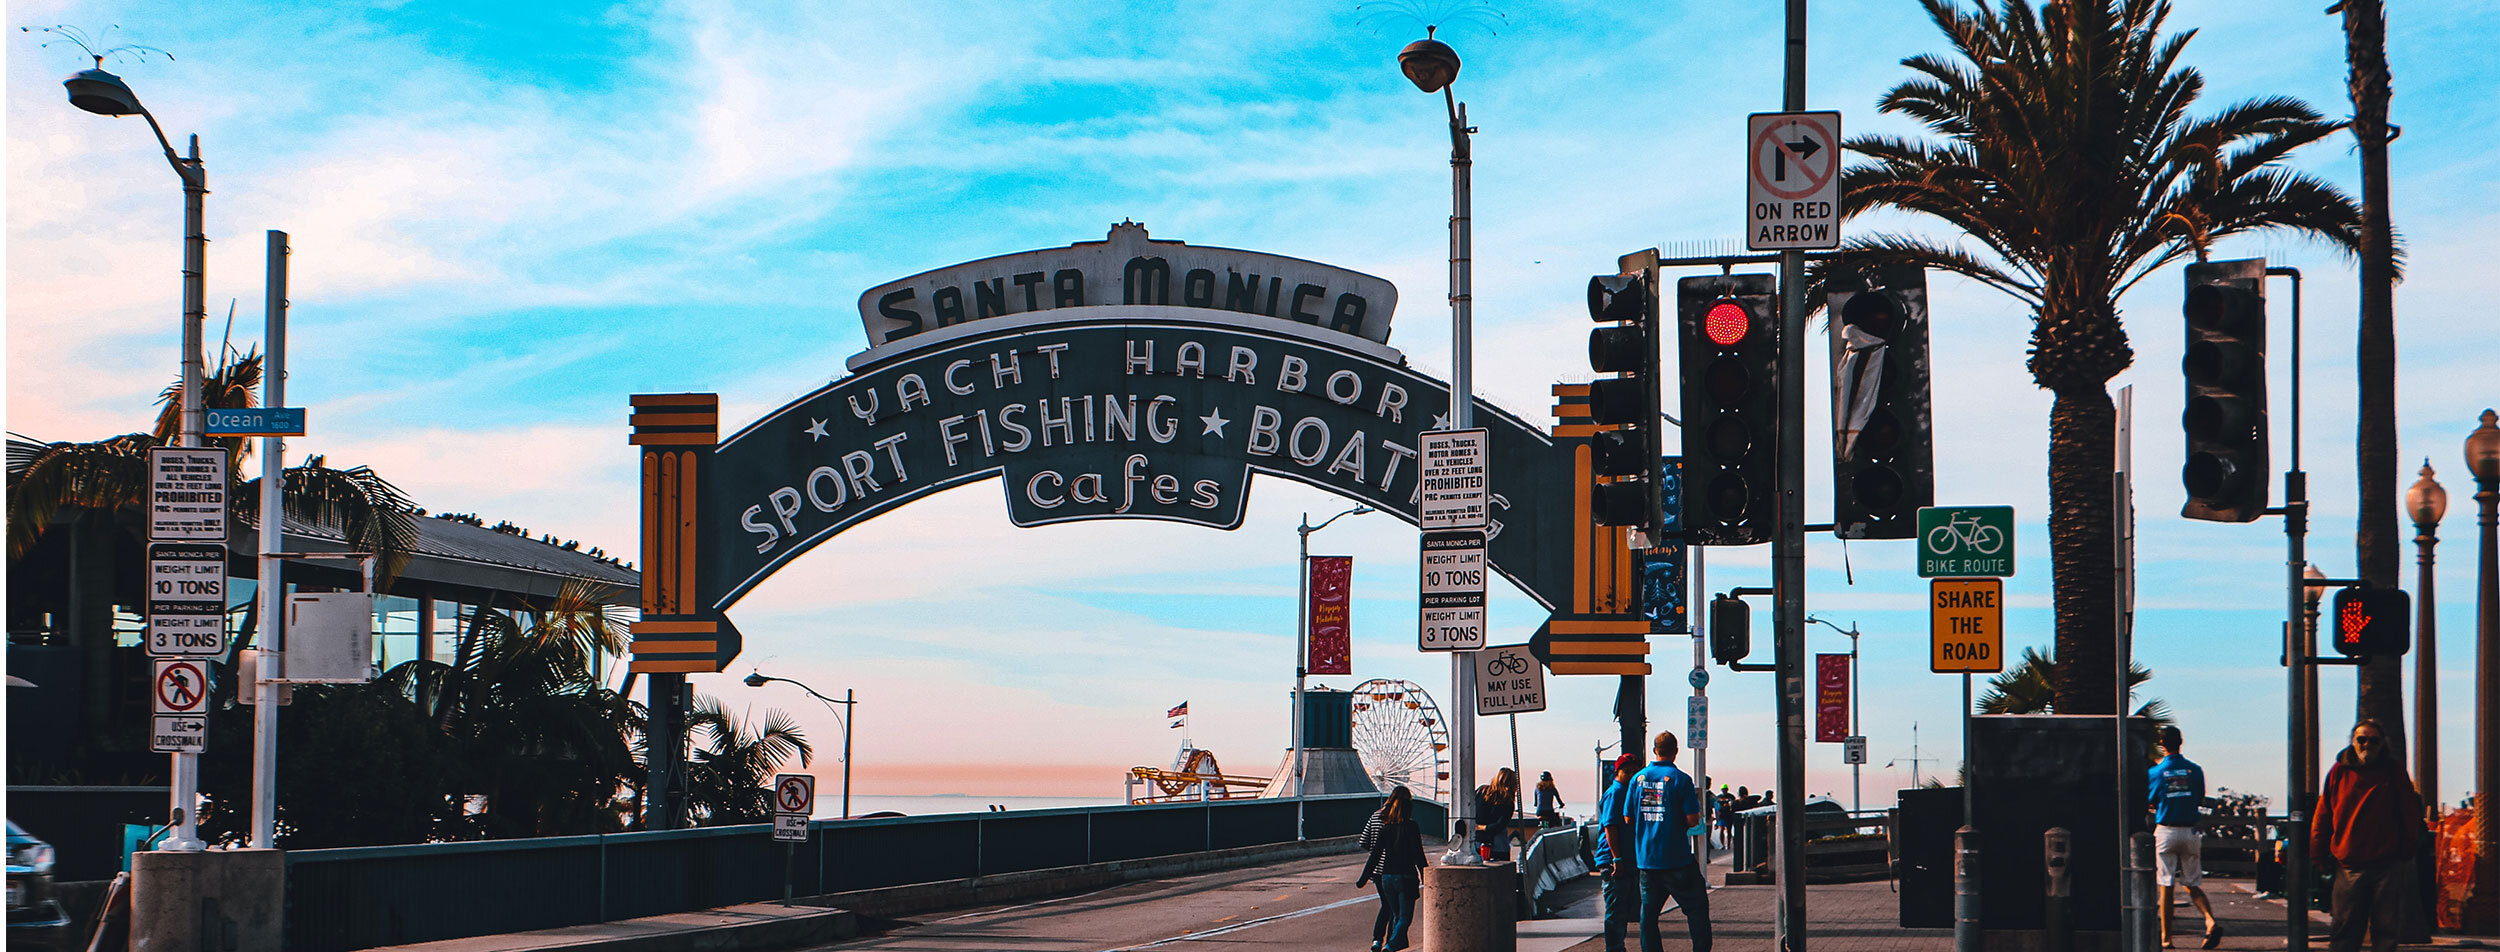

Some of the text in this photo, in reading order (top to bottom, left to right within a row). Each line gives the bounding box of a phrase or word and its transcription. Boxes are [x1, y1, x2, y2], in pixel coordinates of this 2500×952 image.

[1755, 201, 1831, 220] ON RED
[1758, 223, 1829, 242] ARROW
[877, 255, 1367, 344] SANTA MONICA
[848, 340, 1408, 426] YACHT HARBOR
[207, 412, 263, 427] Ocean
[1429, 439, 1477, 449] BUSES, TRUCKS,
[1428, 448, 1478, 458] MOTOR HOMES &
[1433, 458, 1473, 467] ALL VEHICLES
[741, 431, 908, 555] SPORT
[938, 394, 1179, 467] FISHING
[1424, 466, 1482, 477] OVER 22 FEET LONG
[1026, 453, 1221, 514] cafes
[1424, 476, 1483, 491] PROHIBITED
[155, 491, 222, 503] PROHIBITED
[1424, 493, 1438, 501] PRC
[1467, 504, 1482, 513] ONLY
[1446, 539, 1468, 547] MONICA
[1426, 554, 1481, 564] WEIGHT LIMIT
[1926, 558, 2006, 573] BIKE ROUTE
[155, 565, 220, 574] WEIGHT LIMIT
[1426, 570, 1480, 587] 10 TONS
[155, 580, 219, 594] 10 TONS
[1441, 596, 1467, 604] PARKING
[1937, 590, 1995, 608] SHARE
[154, 619, 219, 627] WEIGHT LIMIT
[1425, 611, 1480, 621] WEIGHT LIMIT
[1950, 616, 1983, 634] THE
[156, 633, 217, 647] 3 TONS
[1426, 626, 1478, 642] 3 TONS
[1943, 642, 1990, 660] ROAD
[1488, 678, 1531, 692] MAY USE
[1483, 693, 1538, 708] FULL LANE
[171, 721, 187, 732] USE
[155, 735, 202, 746] CROSSWALK
[1851, 751, 1860, 761] 5
[787, 819, 796, 827] USE
